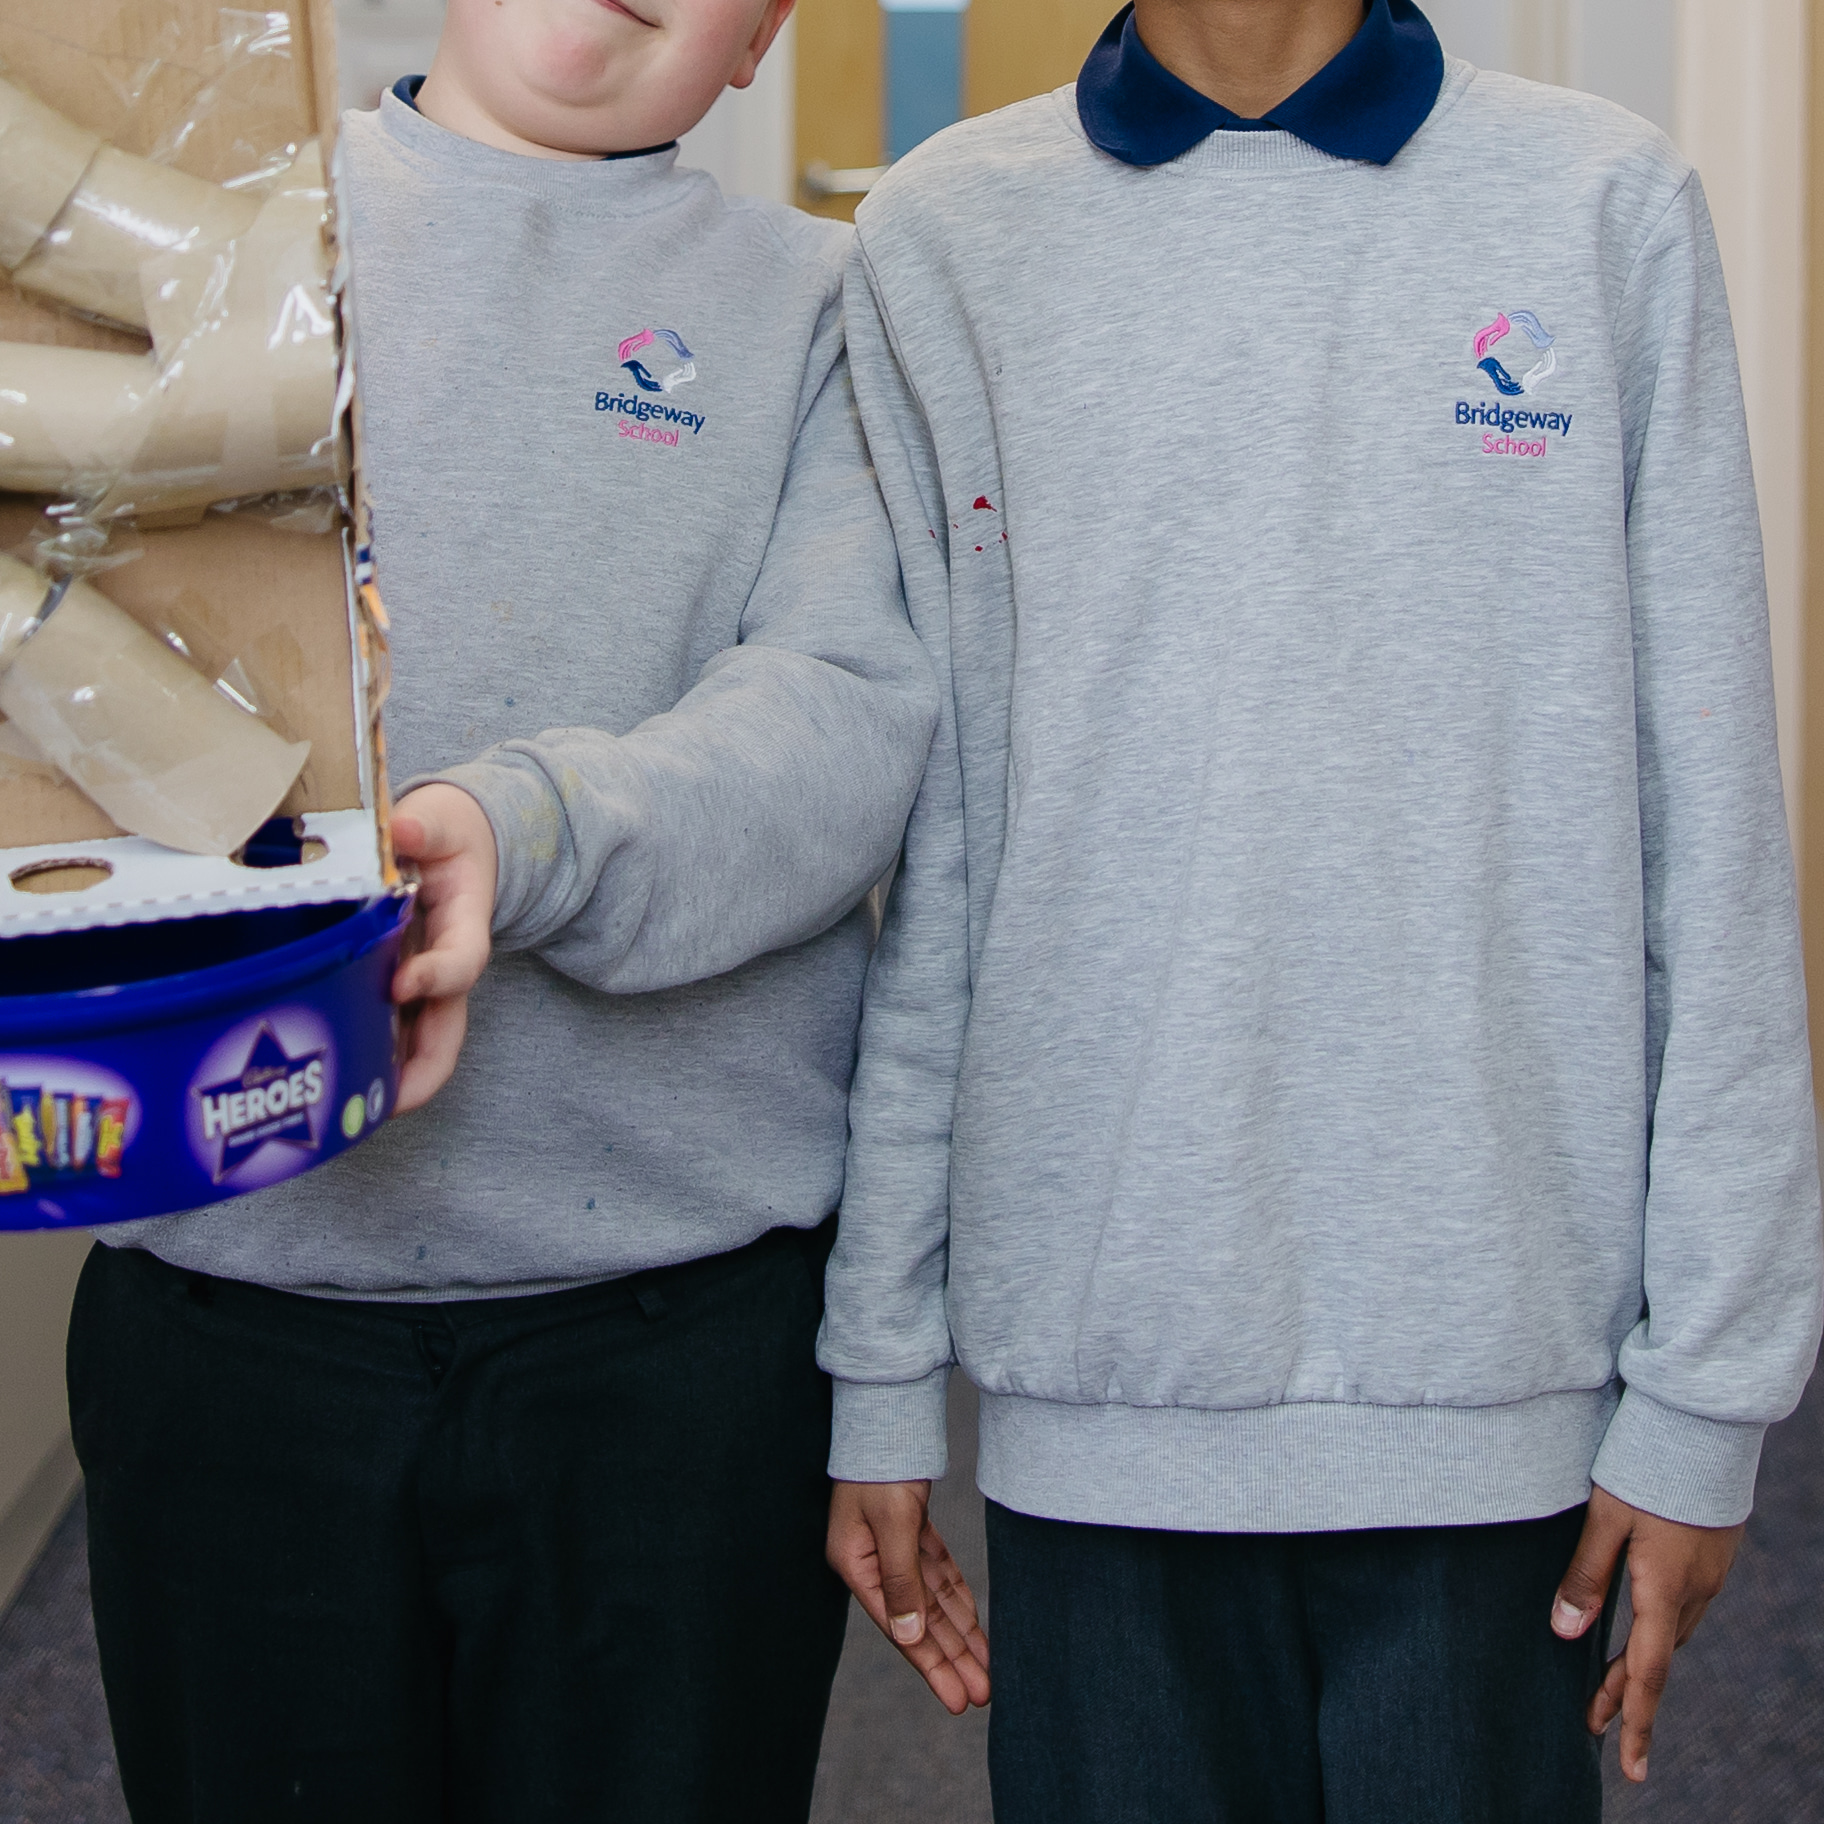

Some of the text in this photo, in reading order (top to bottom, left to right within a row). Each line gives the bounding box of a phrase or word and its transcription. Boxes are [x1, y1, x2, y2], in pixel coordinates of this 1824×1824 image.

[595, 392, 705, 434] Bridgeway
[1455, 401, 1572, 436] Bridgeway
[618, 419, 680, 447] School
[1482, 433, 1546, 457] School
[202, 1060, 323, 1140] HEROES
